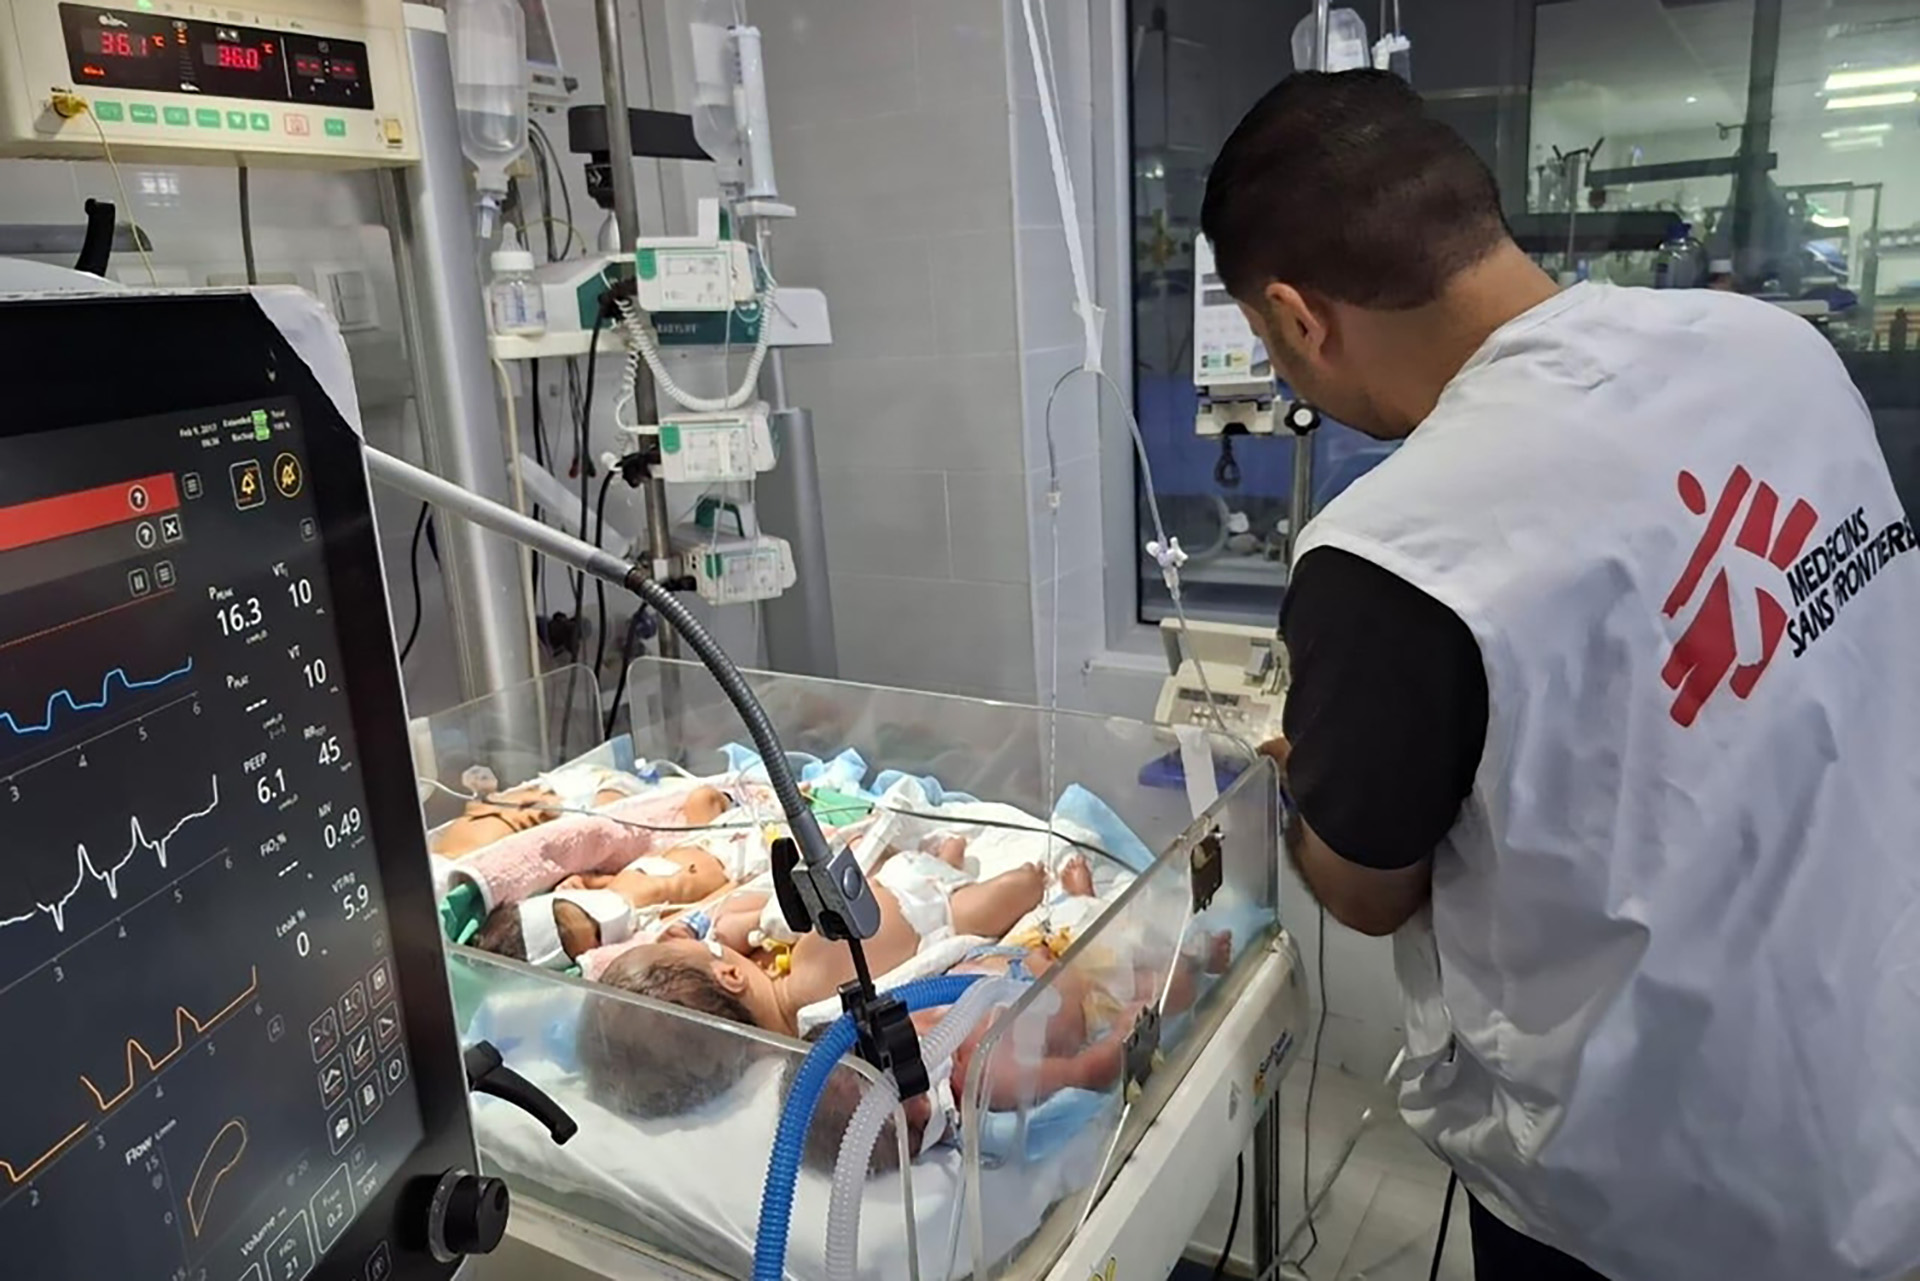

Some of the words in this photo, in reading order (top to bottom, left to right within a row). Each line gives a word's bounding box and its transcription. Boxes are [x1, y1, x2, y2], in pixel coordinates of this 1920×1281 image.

[101, 31, 148, 56] 36.1
[1786, 506, 1869, 608] MEDECINS
[288, 578, 312, 608] 10
[217, 597, 262, 636] 16.3
[1787, 588, 1835, 659] SANS
[303, 658, 326, 688] 10
[318, 736, 341, 765] 45
[257, 767, 286, 804] 6.1
[324, 807, 361, 849] 0.49
[343, 884, 369, 920] 5.9
[296, 931, 310, 957] 0
